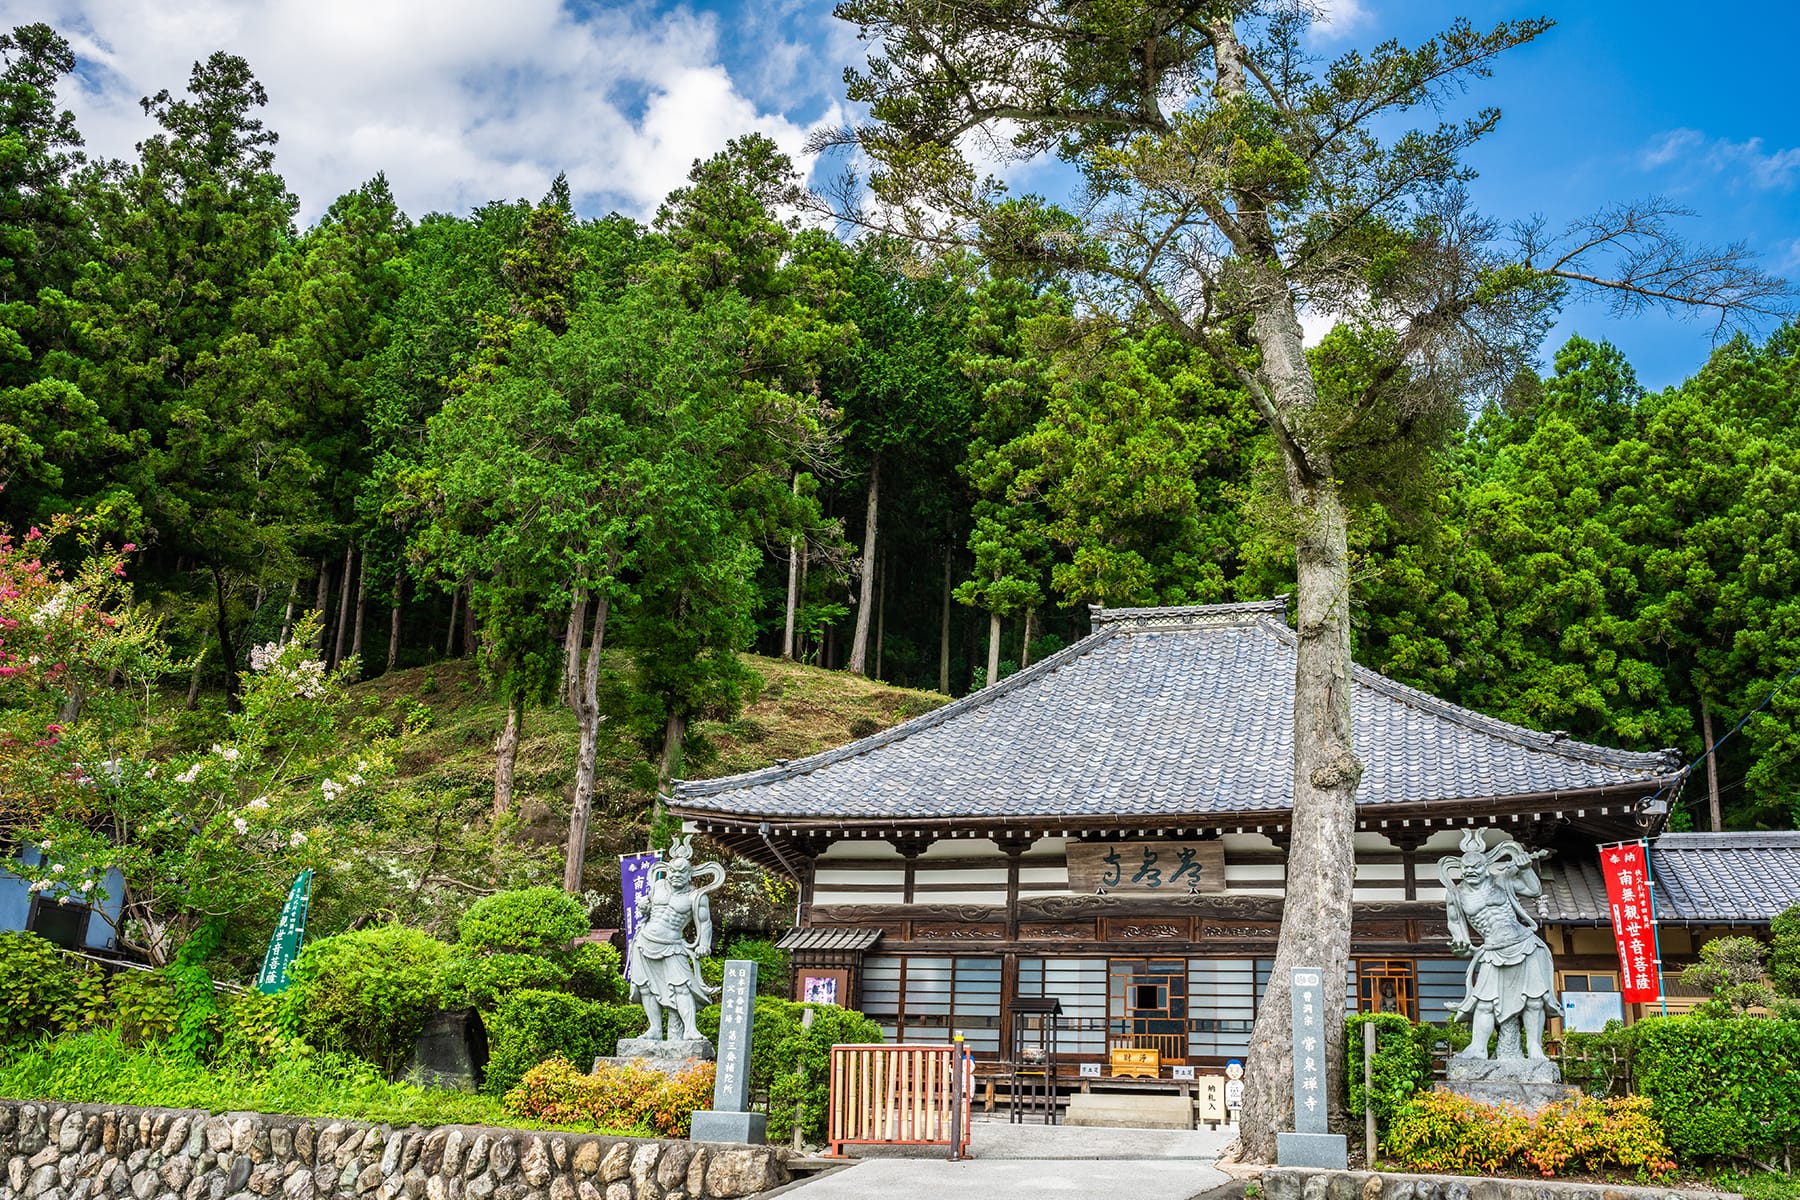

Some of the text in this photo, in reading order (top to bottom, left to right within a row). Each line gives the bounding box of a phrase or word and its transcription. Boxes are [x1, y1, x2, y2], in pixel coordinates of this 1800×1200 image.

[1609, 852, 1635, 864] 奉納
[1617, 869, 1650, 990] 南無観世音菩薩
[1207, 1084, 1216, 1110] 納札入
